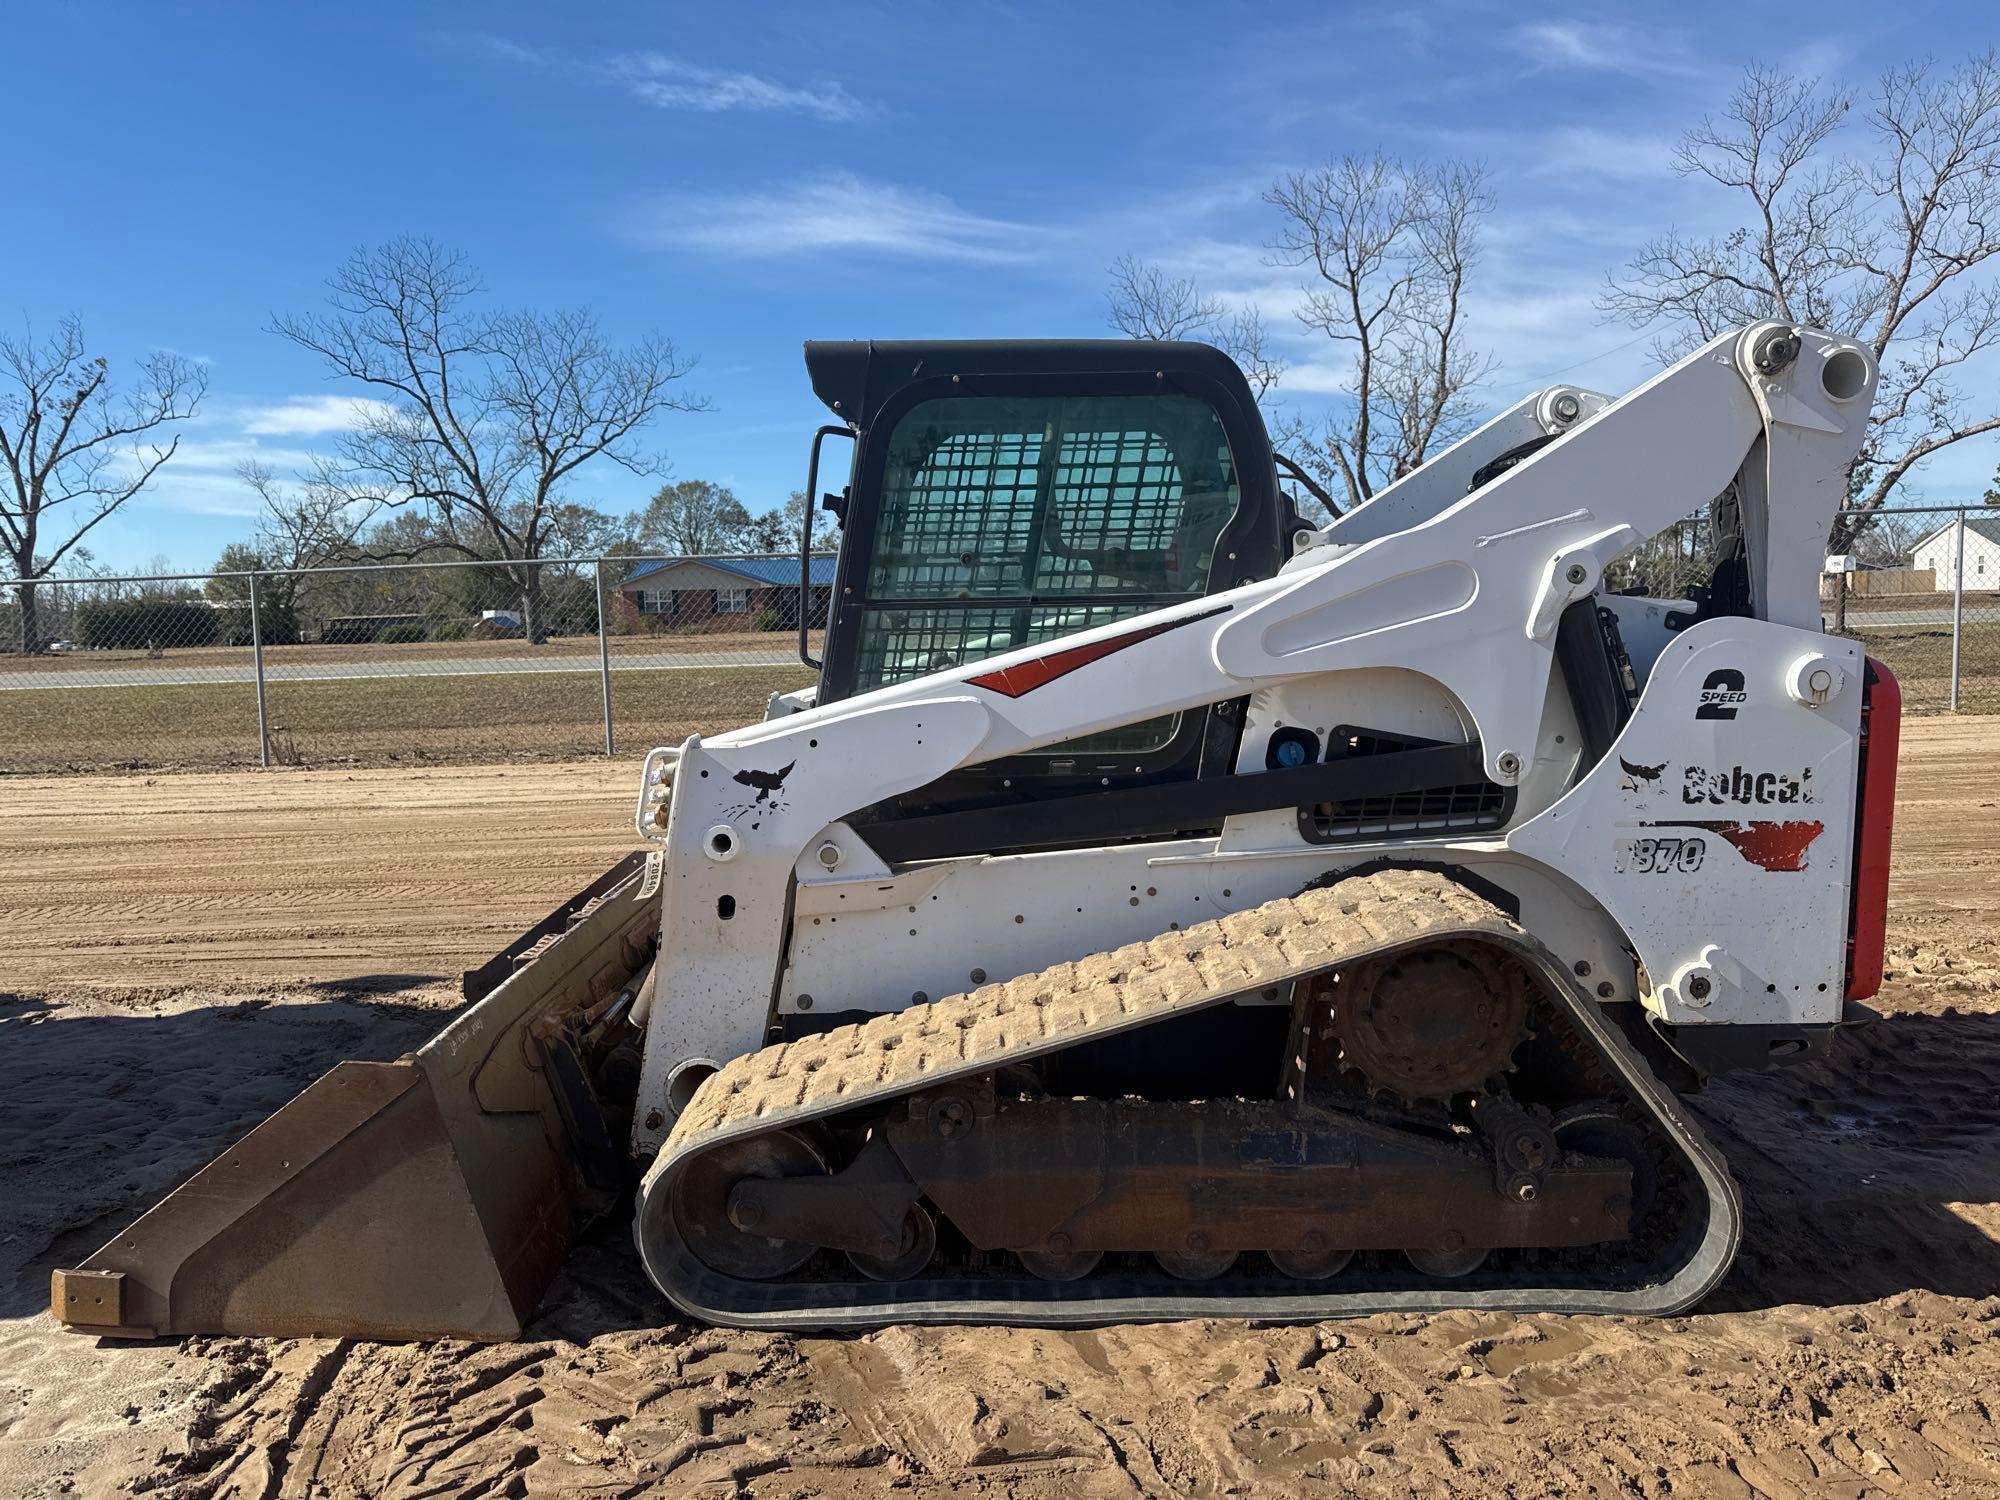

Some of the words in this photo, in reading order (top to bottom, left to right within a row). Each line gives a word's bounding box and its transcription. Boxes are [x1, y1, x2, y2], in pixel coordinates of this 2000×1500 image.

[1695, 668, 1745, 720] 2
[1699, 691, 1747, 702] SPEED
[1614, 837, 1706, 874] 870
